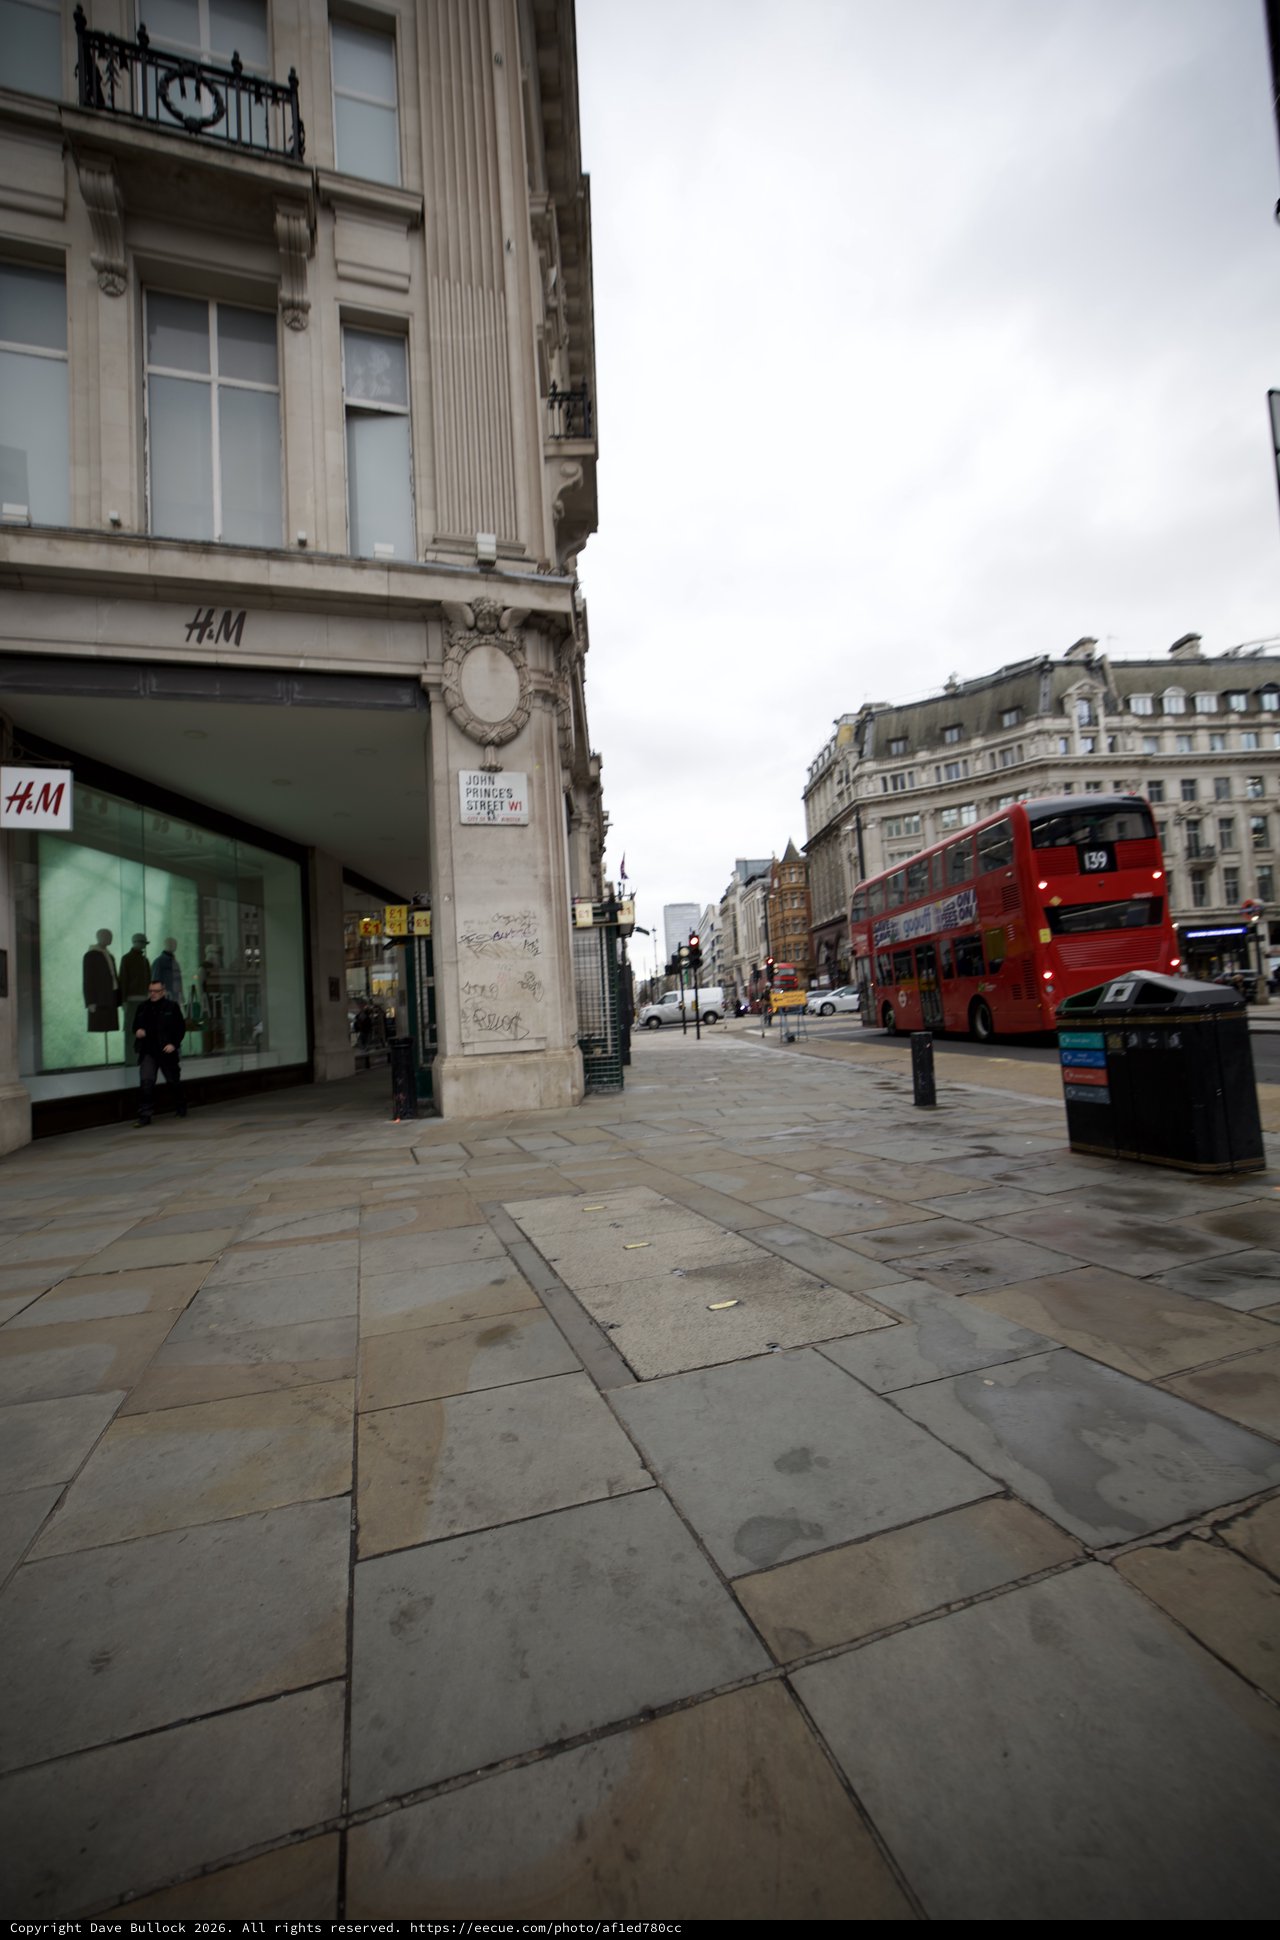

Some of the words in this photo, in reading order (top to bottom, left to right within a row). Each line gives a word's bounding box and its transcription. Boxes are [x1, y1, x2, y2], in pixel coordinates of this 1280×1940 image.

[185, 608, 247, 647] H&M
[466, 775, 495, 786] JOHN
[5, 781, 66, 816] H&M
[466, 788, 513, 799] PRINCE'S
[467, 800, 504, 811] STREET
[509, 801, 522, 812] W1
[1084, 850, 1108, 870] 139
